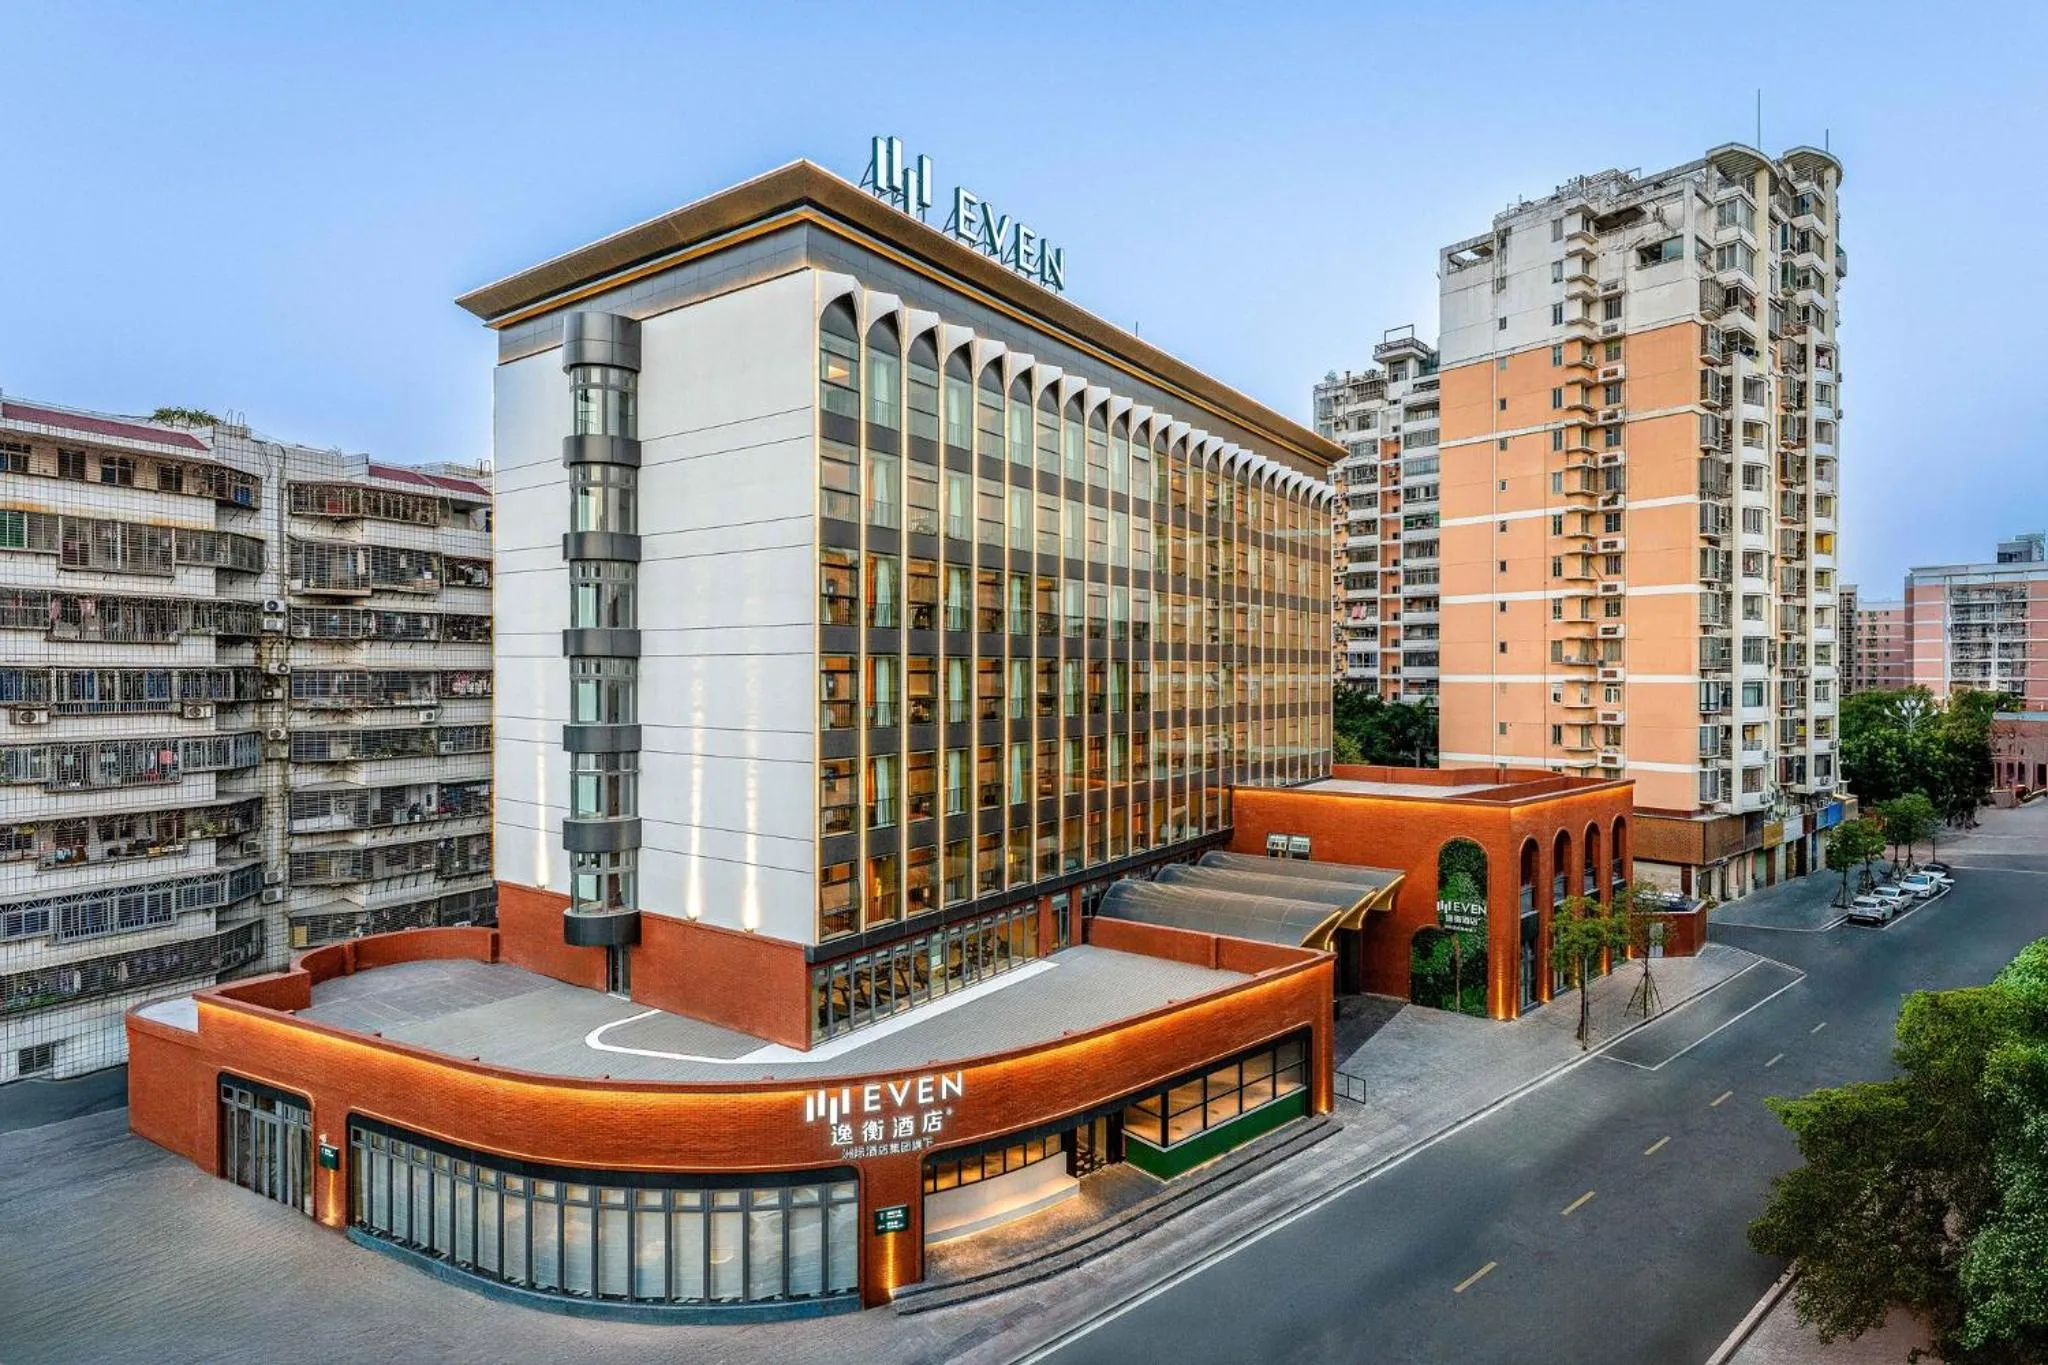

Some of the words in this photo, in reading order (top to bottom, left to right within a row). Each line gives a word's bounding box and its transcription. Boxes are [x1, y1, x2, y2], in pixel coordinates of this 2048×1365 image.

[954, 186, 1064, 290] EVEN
[1454, 902, 1487, 915] EVEN
[864, 1071, 962, 1112] EVEN
[832, 1109, 944, 1147] 逸衡酒店
